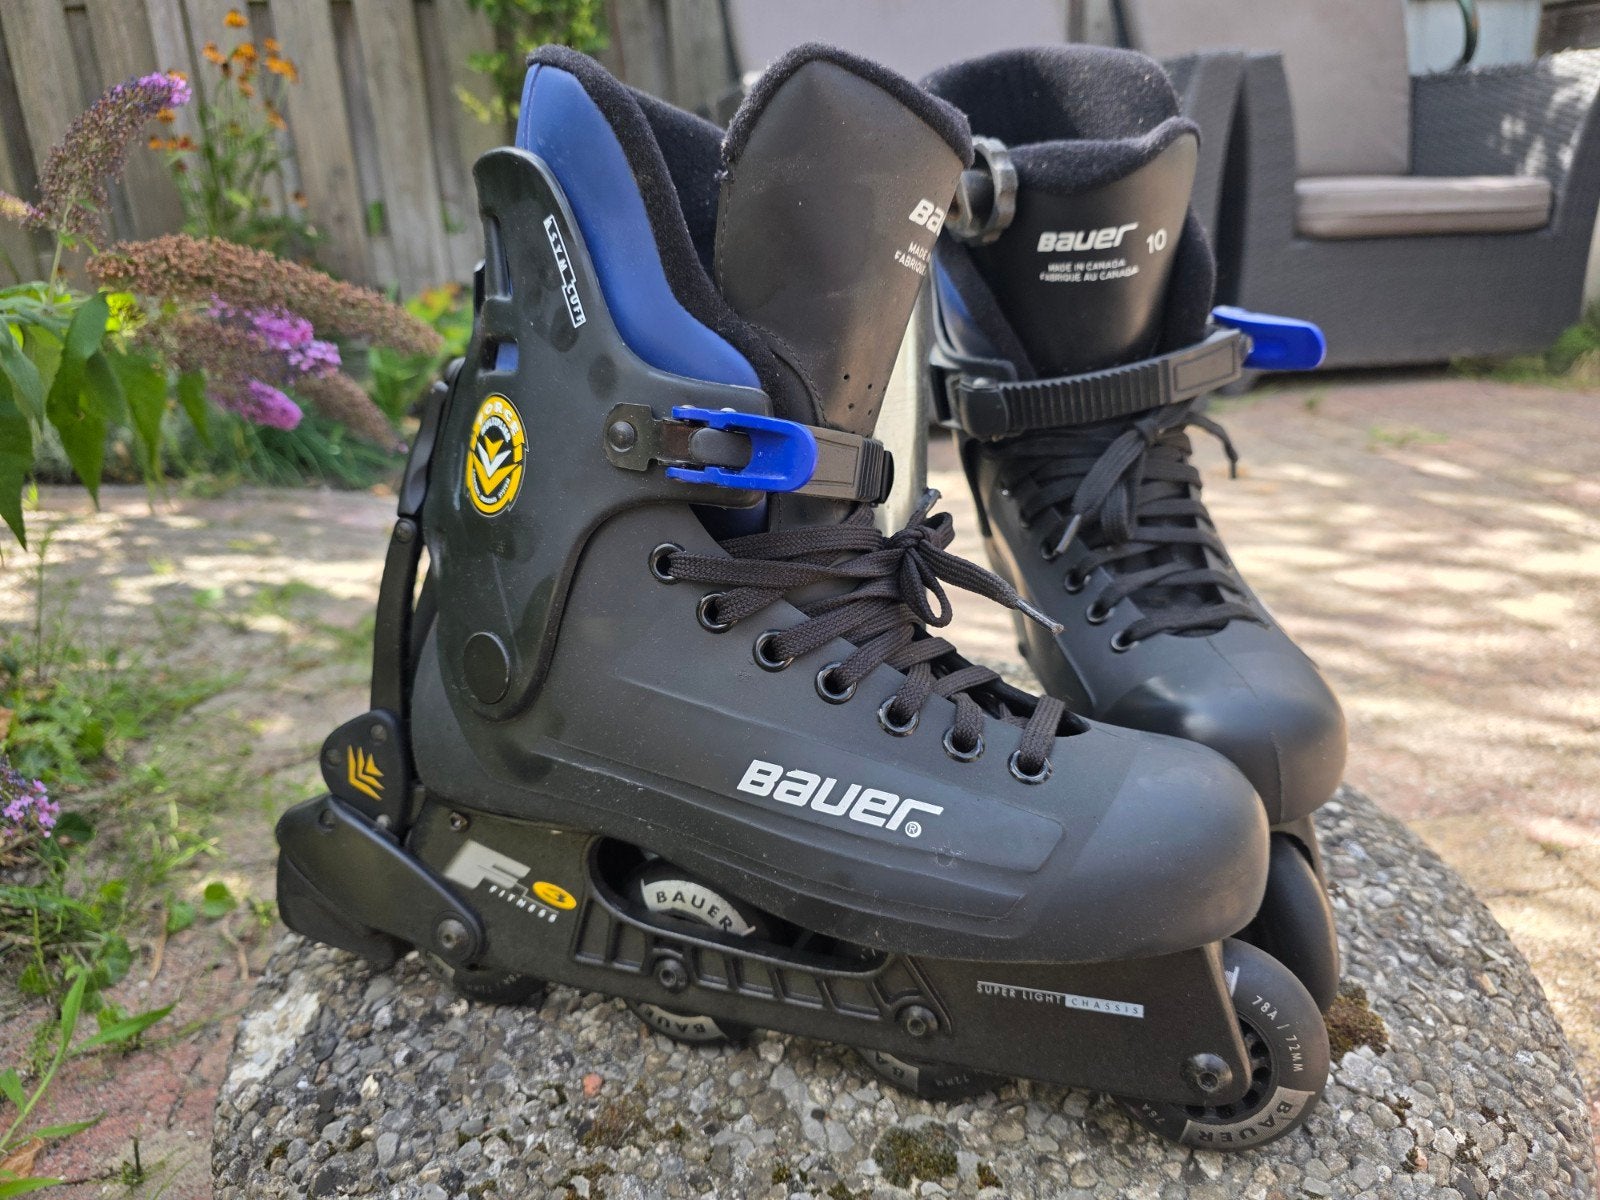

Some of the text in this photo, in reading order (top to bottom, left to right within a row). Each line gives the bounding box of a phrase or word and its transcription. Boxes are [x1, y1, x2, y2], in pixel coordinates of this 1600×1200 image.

[909, 199, 946, 237] Ba
[908, 241, 929, 262] MADE
[1145, 228, 1168, 254] 10
[543, 217, 585, 323] ASYM CUFF
[894, 249, 926, 276] FABRIQU
[1039, 265, 1140, 282] FABRIQUE AU CANADA
[1047, 258, 1127, 273] MADE IN CANADA
[489, 885, 558, 923] FITNESS
[656, 890, 733, 933] BAUER
[976, 983, 1138, 1014] SUPER LIGHT CHASSIS
[1252, 995, 1278, 1020] 78A
[1285, 1034, 1304, 1072] 72MM
[1199, 1100, 1294, 1142] BAUER
